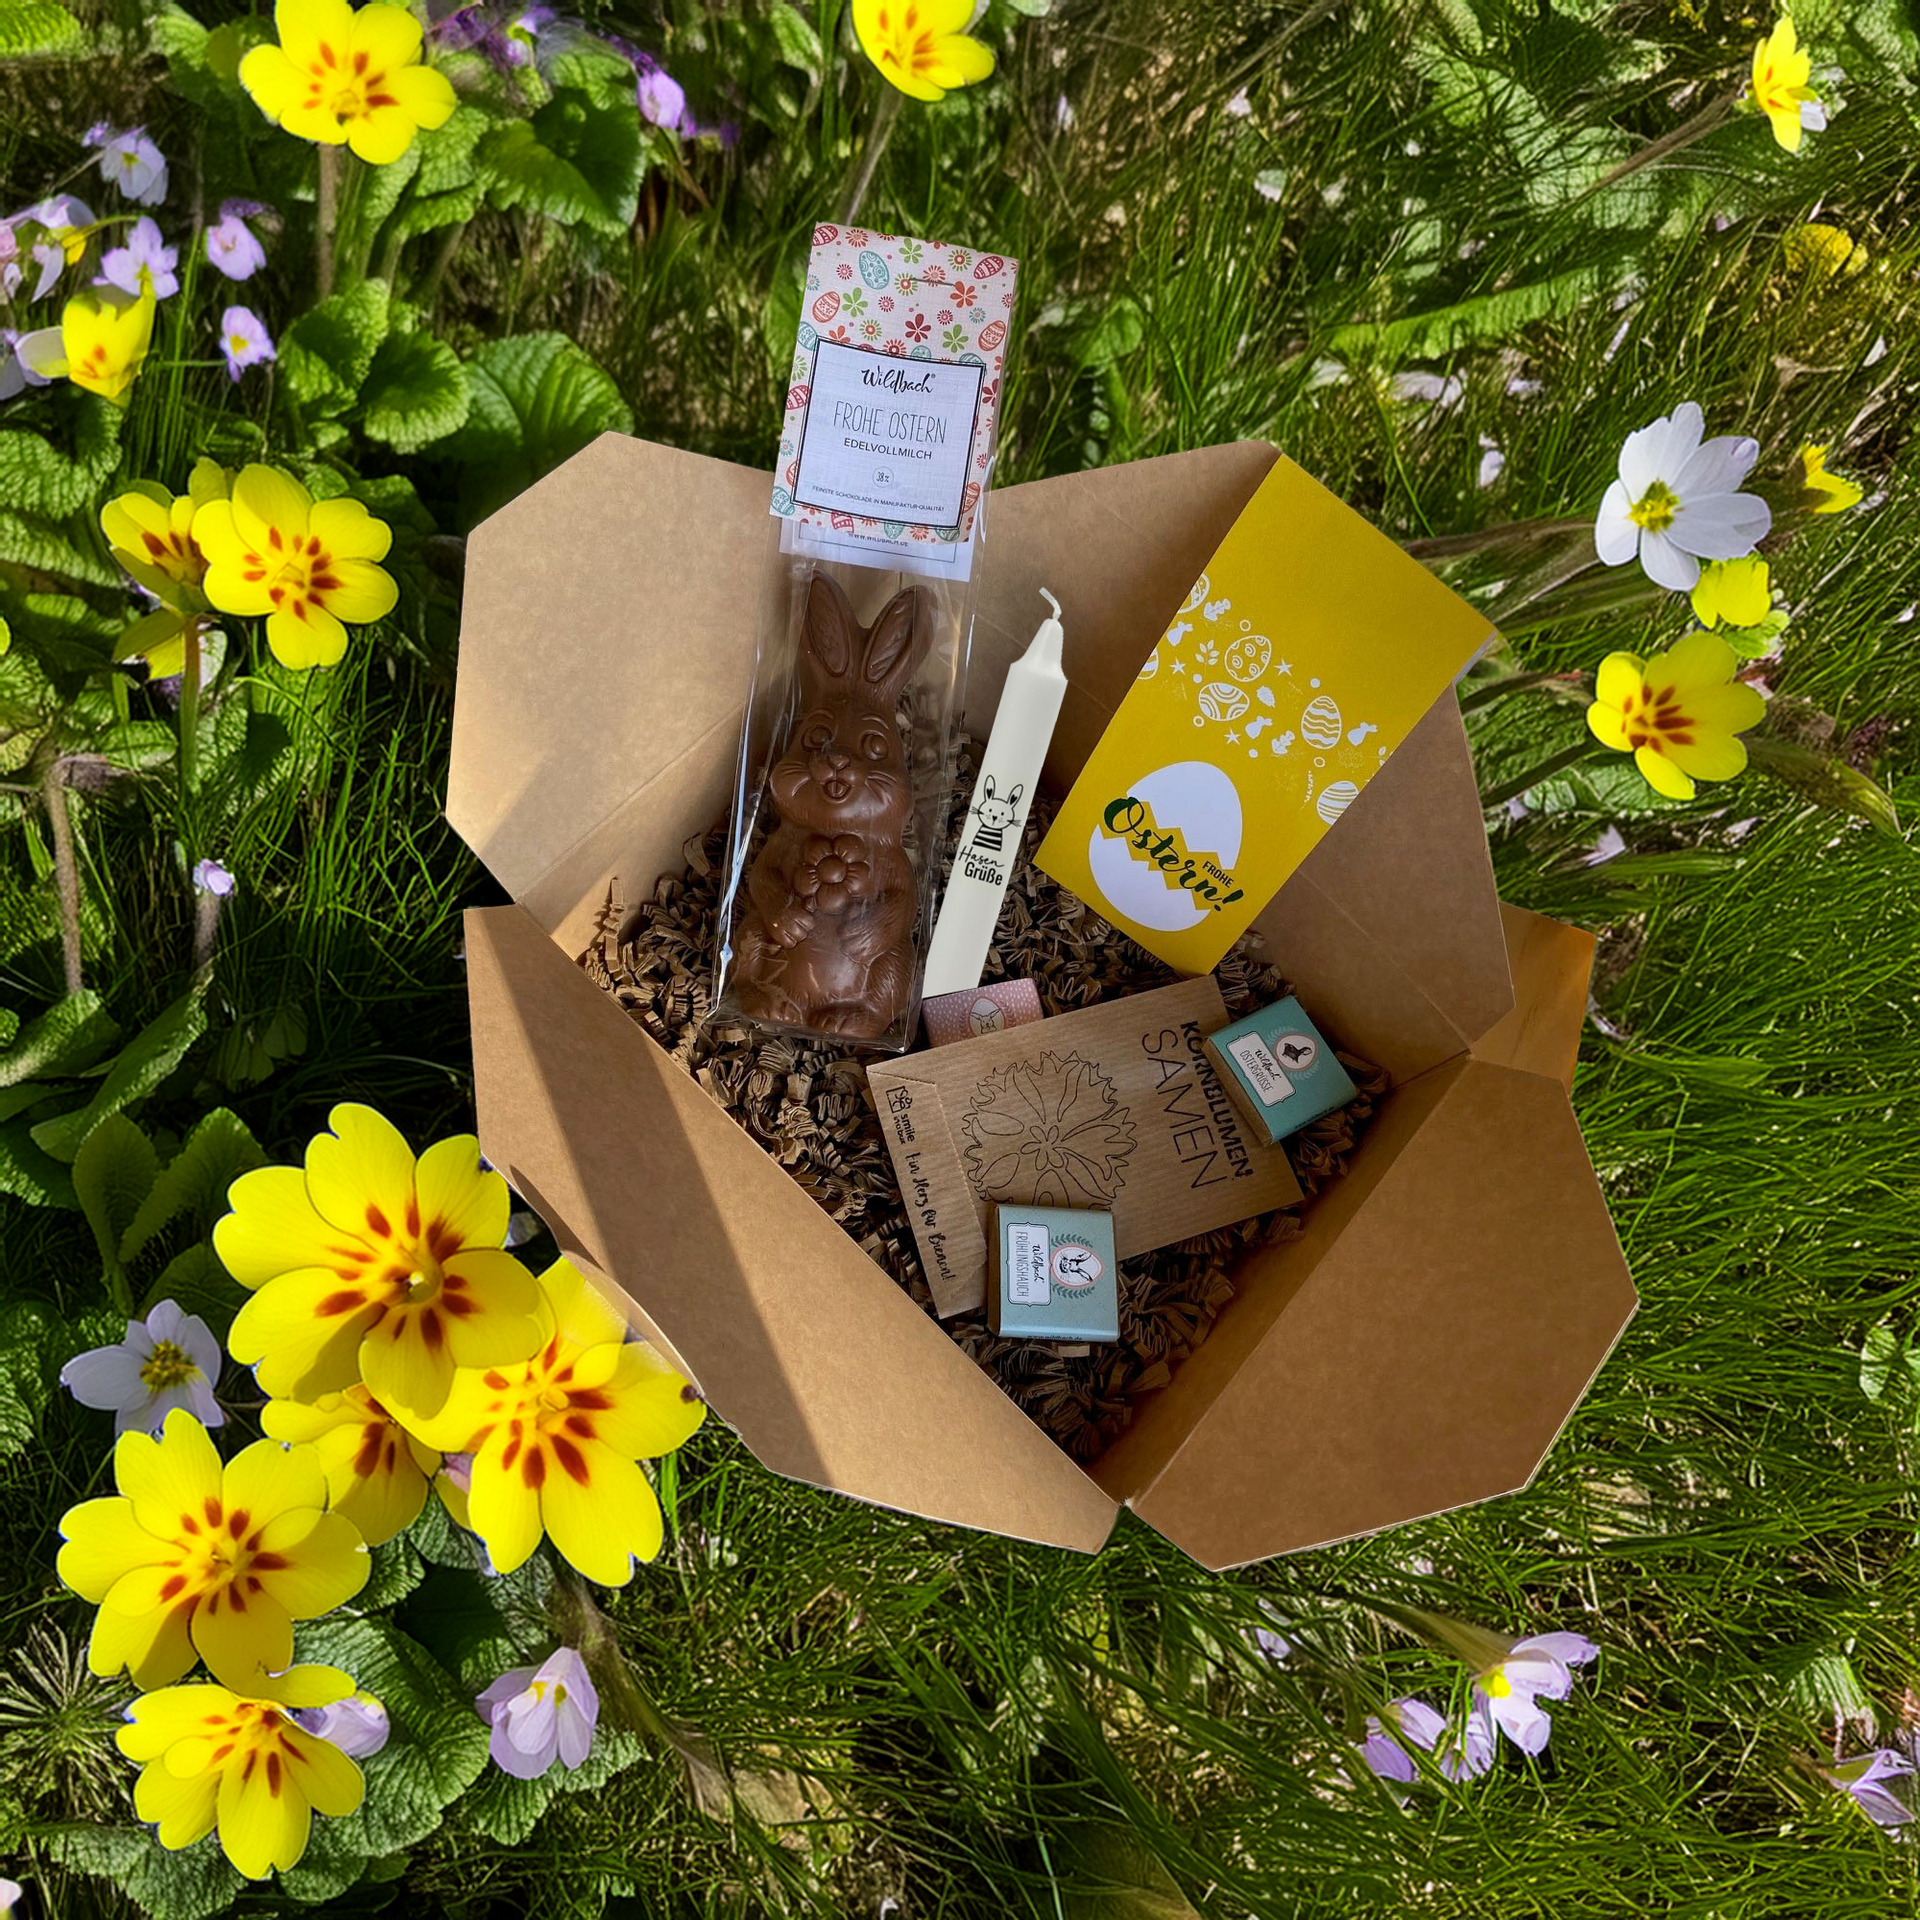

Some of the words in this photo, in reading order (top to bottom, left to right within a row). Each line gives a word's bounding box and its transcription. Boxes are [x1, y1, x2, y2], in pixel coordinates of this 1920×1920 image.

[833, 400, 883, 437] FROHE
[888, 411, 947, 444] OSTERN
[843, 438, 933, 460] EDELVOLLMILCH
[812, 485, 834, 495] FEINSTE
[835, 491, 873, 503] SCHOKOLADE
[958, 845, 1005, 867] Hasen
[1104, 796, 1244, 912] Ostern!
[964, 861, 1003, 886] Grüße
[1202, 860, 1235, 889] FROHE
[1239, 1049, 1274, 1093] OSTERGRÜSSE
[1142, 1029, 1228, 1189] SAMEN
[900, 1113, 916, 1142] smile
[912, 1178, 930, 1207] Herz
[921, 1208, 937, 1229] für
[1015, 1231, 1030, 1297] FRÜHLINGSHAUCH
